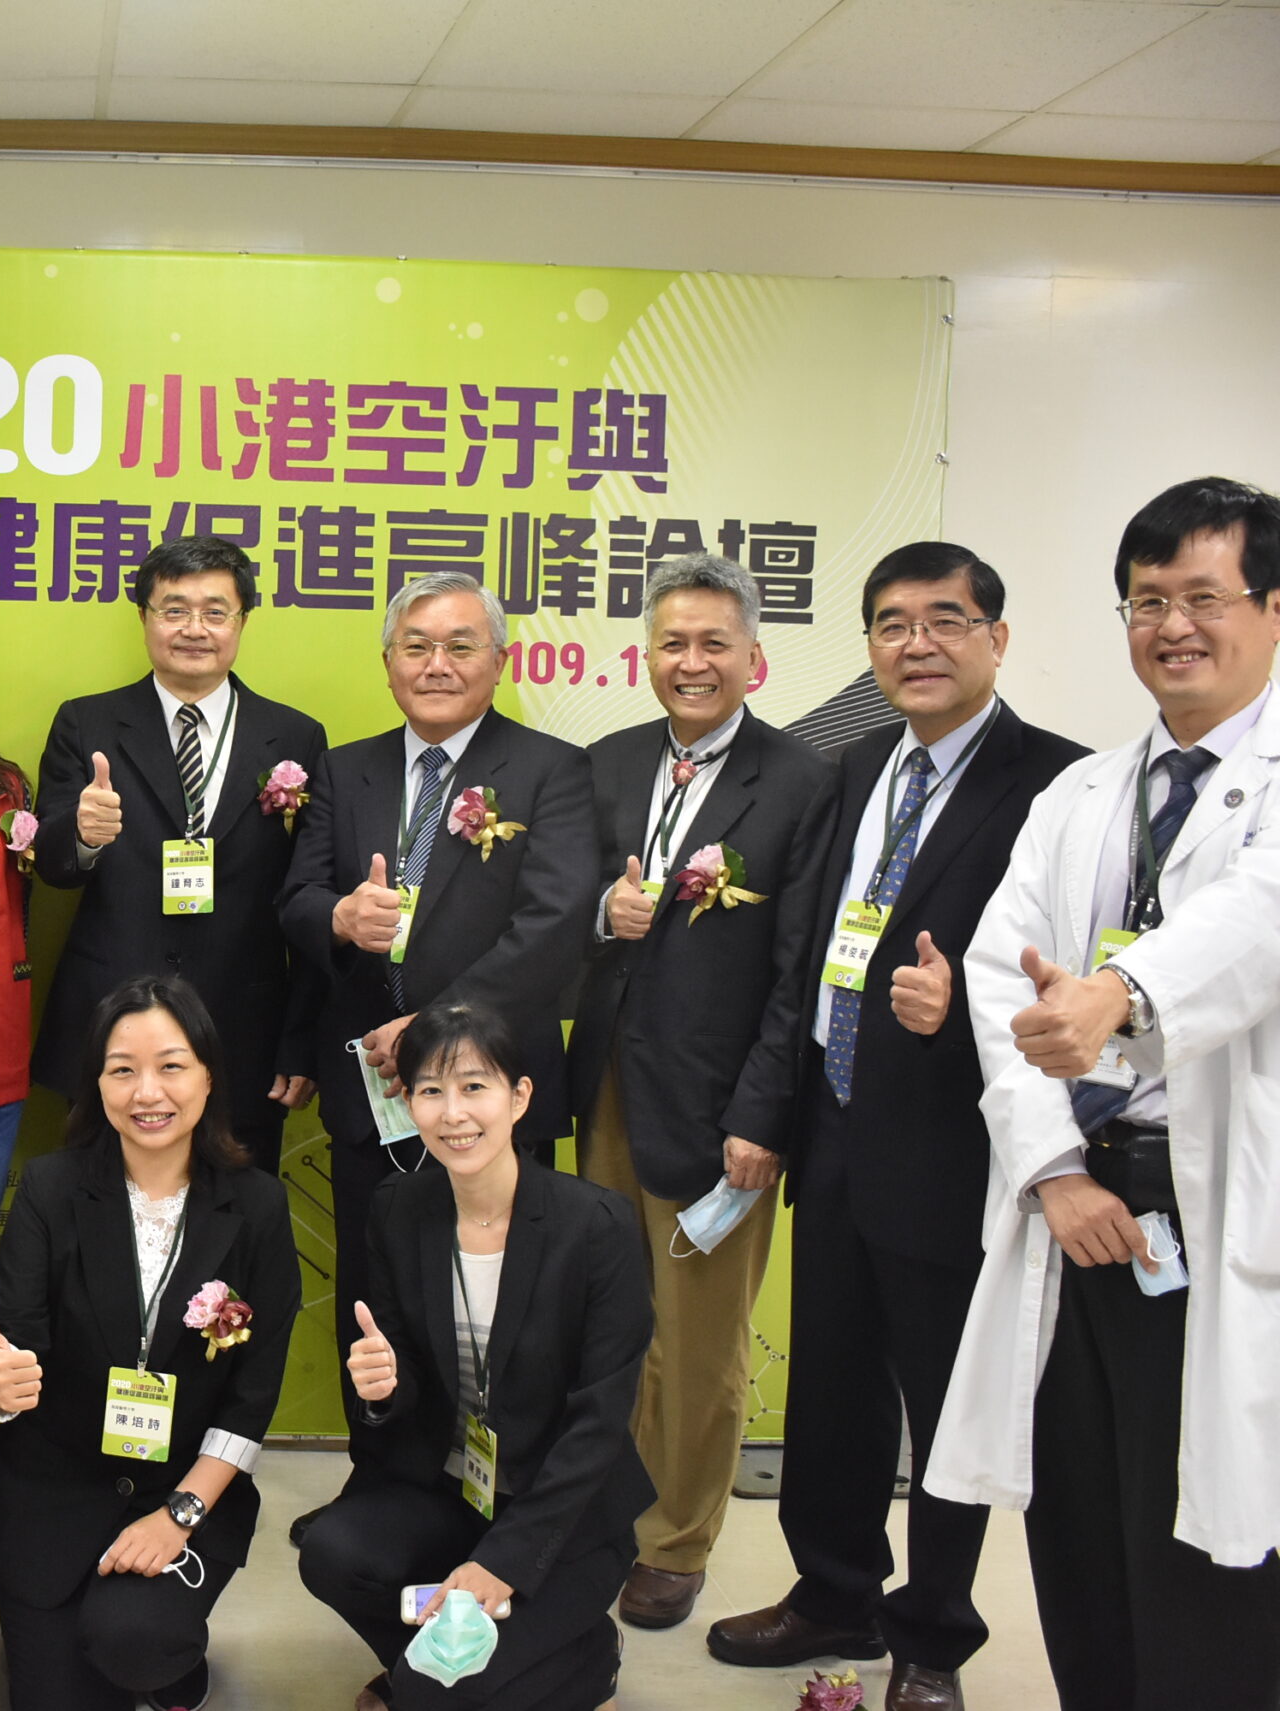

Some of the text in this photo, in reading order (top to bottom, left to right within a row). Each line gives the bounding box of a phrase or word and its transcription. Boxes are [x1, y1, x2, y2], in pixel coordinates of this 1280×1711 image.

[119, 374, 669, 494] 小港空汙與
[116, 1413, 161, 1431] 陳培詩
